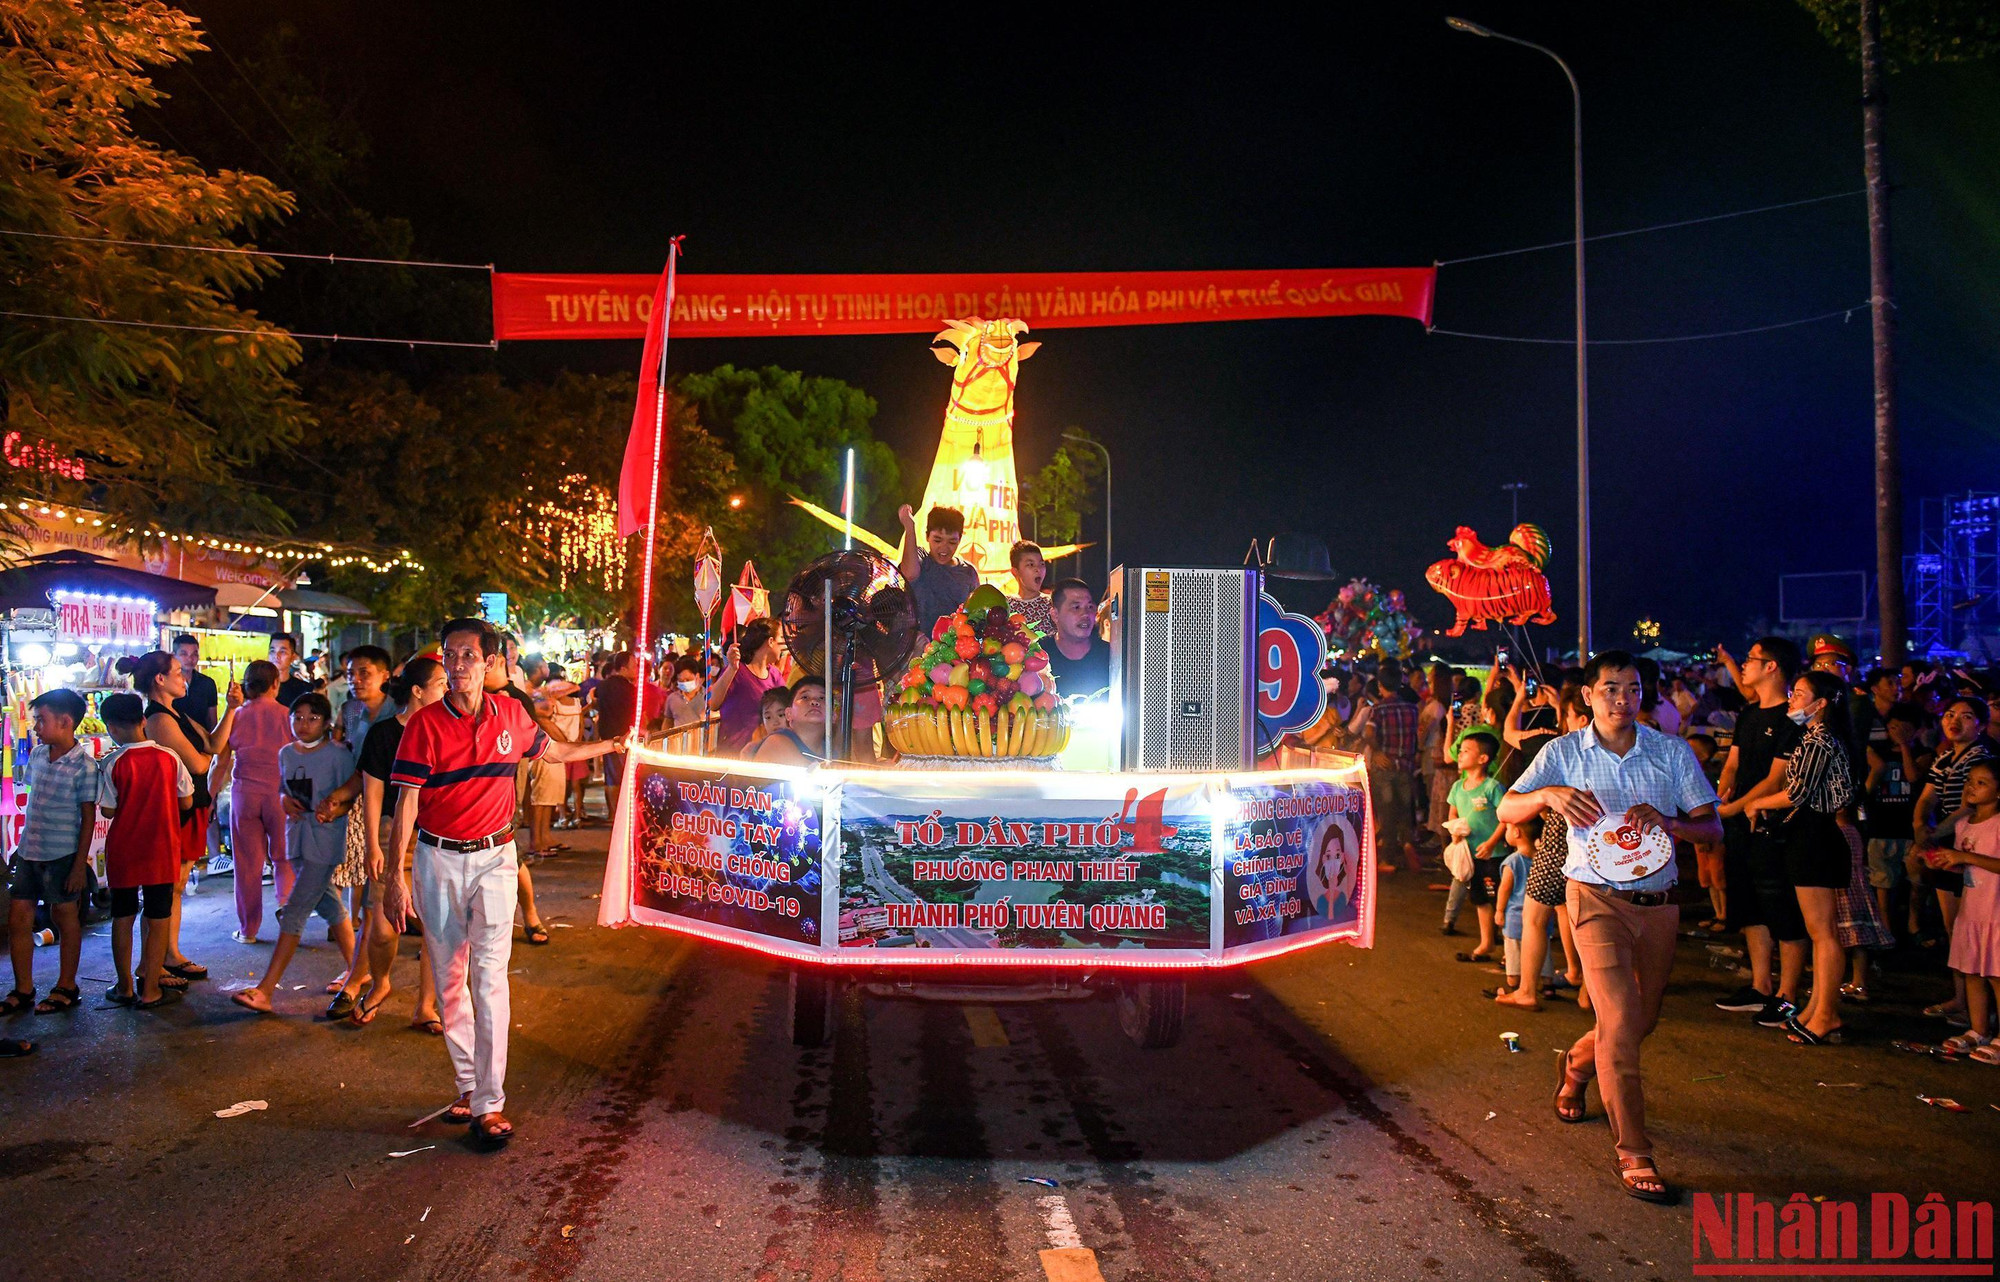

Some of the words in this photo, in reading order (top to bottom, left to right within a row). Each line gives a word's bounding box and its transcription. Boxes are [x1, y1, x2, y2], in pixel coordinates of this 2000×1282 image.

[546, 288, 630, 322] TUYÊN
[636, 293, 727, 322] QANG
[747, 288, 792, 329] HỘI
[796, 294, 828, 329] TỤ
[833, 293, 890, 320] TINH
[897, 293, 948, 319] HOA
[955, 291, 979, 318] DI
[985, 284, 1031, 318] SẢN
[1036, 286, 1085, 317] VĂN
[1091, 285, 1139, 314] HÓA
[1146, 290, 1184, 311] PHI
[1189, 284, 1233, 314] VẬT
[1236, 279, 1283, 307] THỂ
[1286, 279, 1352, 306] QUỐC
[60, 599, 90, 637] TRÀ
[678, 780, 726, 806] TOÀN
[730, 786, 772, 811] DÂN
[1235, 796, 1274, 822] PHÒNG
[1314, 794, 1359, 815] COVID-19
[672, 812, 736, 839] CHUNG
[742, 823, 782, 846] TAY
[895, 809, 944, 846] TỔ
[956, 816, 1033, 847] DÂN
[1042, 812, 1121, 847] PHỐ
[1118, 787, 1178, 853] 4
[1235, 833, 1251, 850] LÀ
[1255, 829, 1283, 848] BẢO
[1287, 828, 1303, 849] VỆ
[666, 842, 722, 870] PHÒNG
[727, 851, 790, 882] CHỐNG
[913, 856, 1006, 881] PHƯỜNG
[1013, 861, 1073, 882] PHAN
[1079, 855, 1140, 882] THIẾT
[1233, 856, 1273, 876] CHÍNH
[1277, 855, 1303, 873] BẠN
[659, 872, 702, 898] DỊCH
[707, 883, 800, 917] COVID-19
[1240, 885, 1262, 900] GIA
[1266, 877, 1297, 894] ĐÌNH
[886, 900, 957, 928] THÀNH
[964, 896, 1012, 928] PHỐ
[1014, 901, 1083, 928] TUYÊN
[1089, 904, 1165, 932] QUANG
[1234, 904, 1255, 925] VÀ
[1257, 902, 1277, 919] XÃ
[1280, 897, 1301, 918] HỘI
